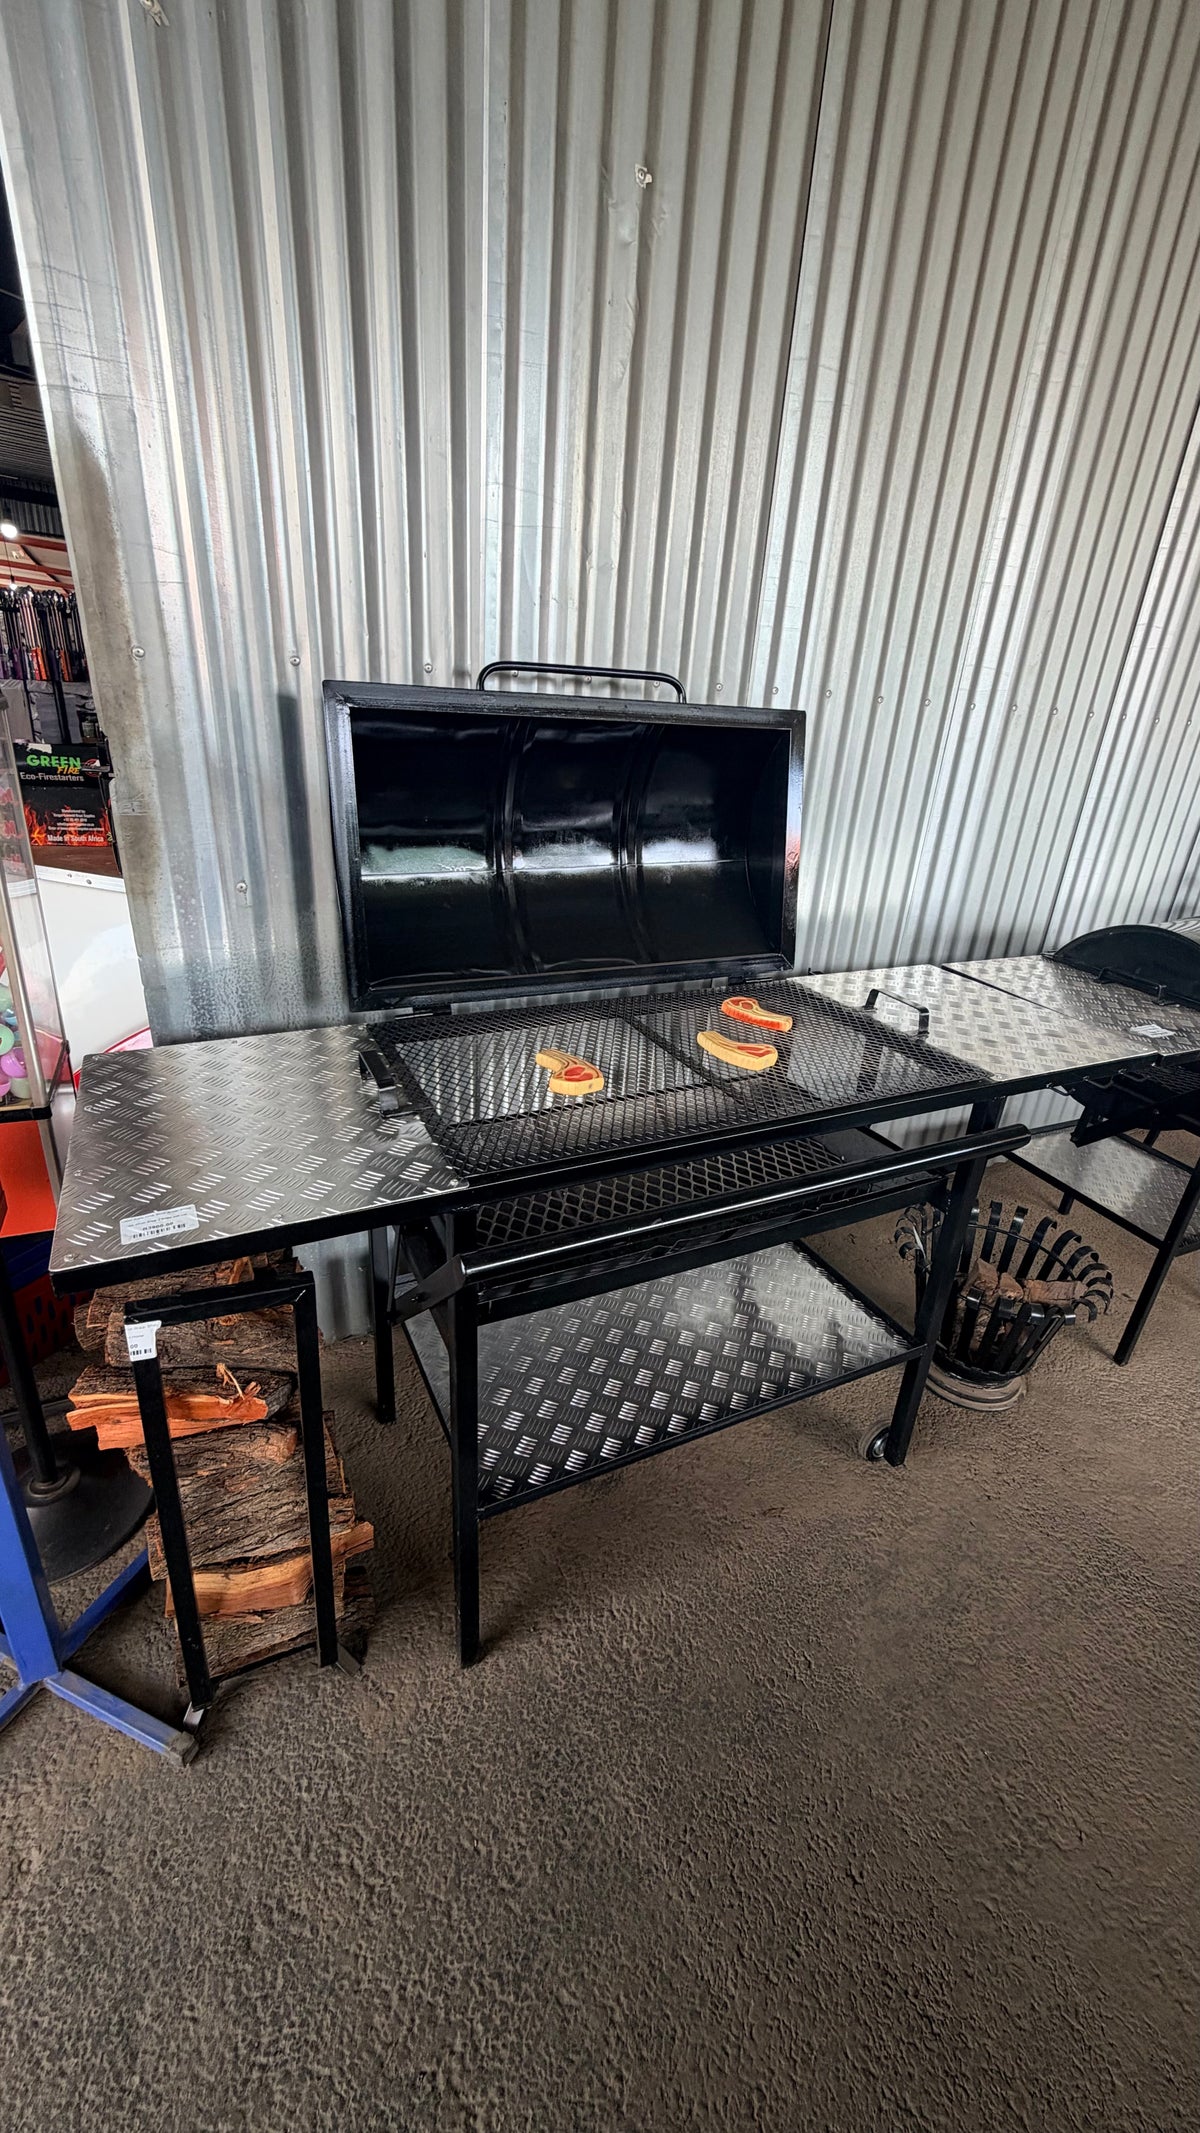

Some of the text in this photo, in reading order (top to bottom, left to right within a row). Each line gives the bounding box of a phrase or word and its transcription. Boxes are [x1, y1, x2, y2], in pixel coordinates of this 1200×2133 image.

[26, 754, 81, 769] GREEN
[57, 765, 80, 775] FIRE
[20, 771, 84, 782] Eco-Firestarters
[47, 834, 63, 842] Made
[71, 834, 87, 842] South
[88, 834, 104, 842] Africa
